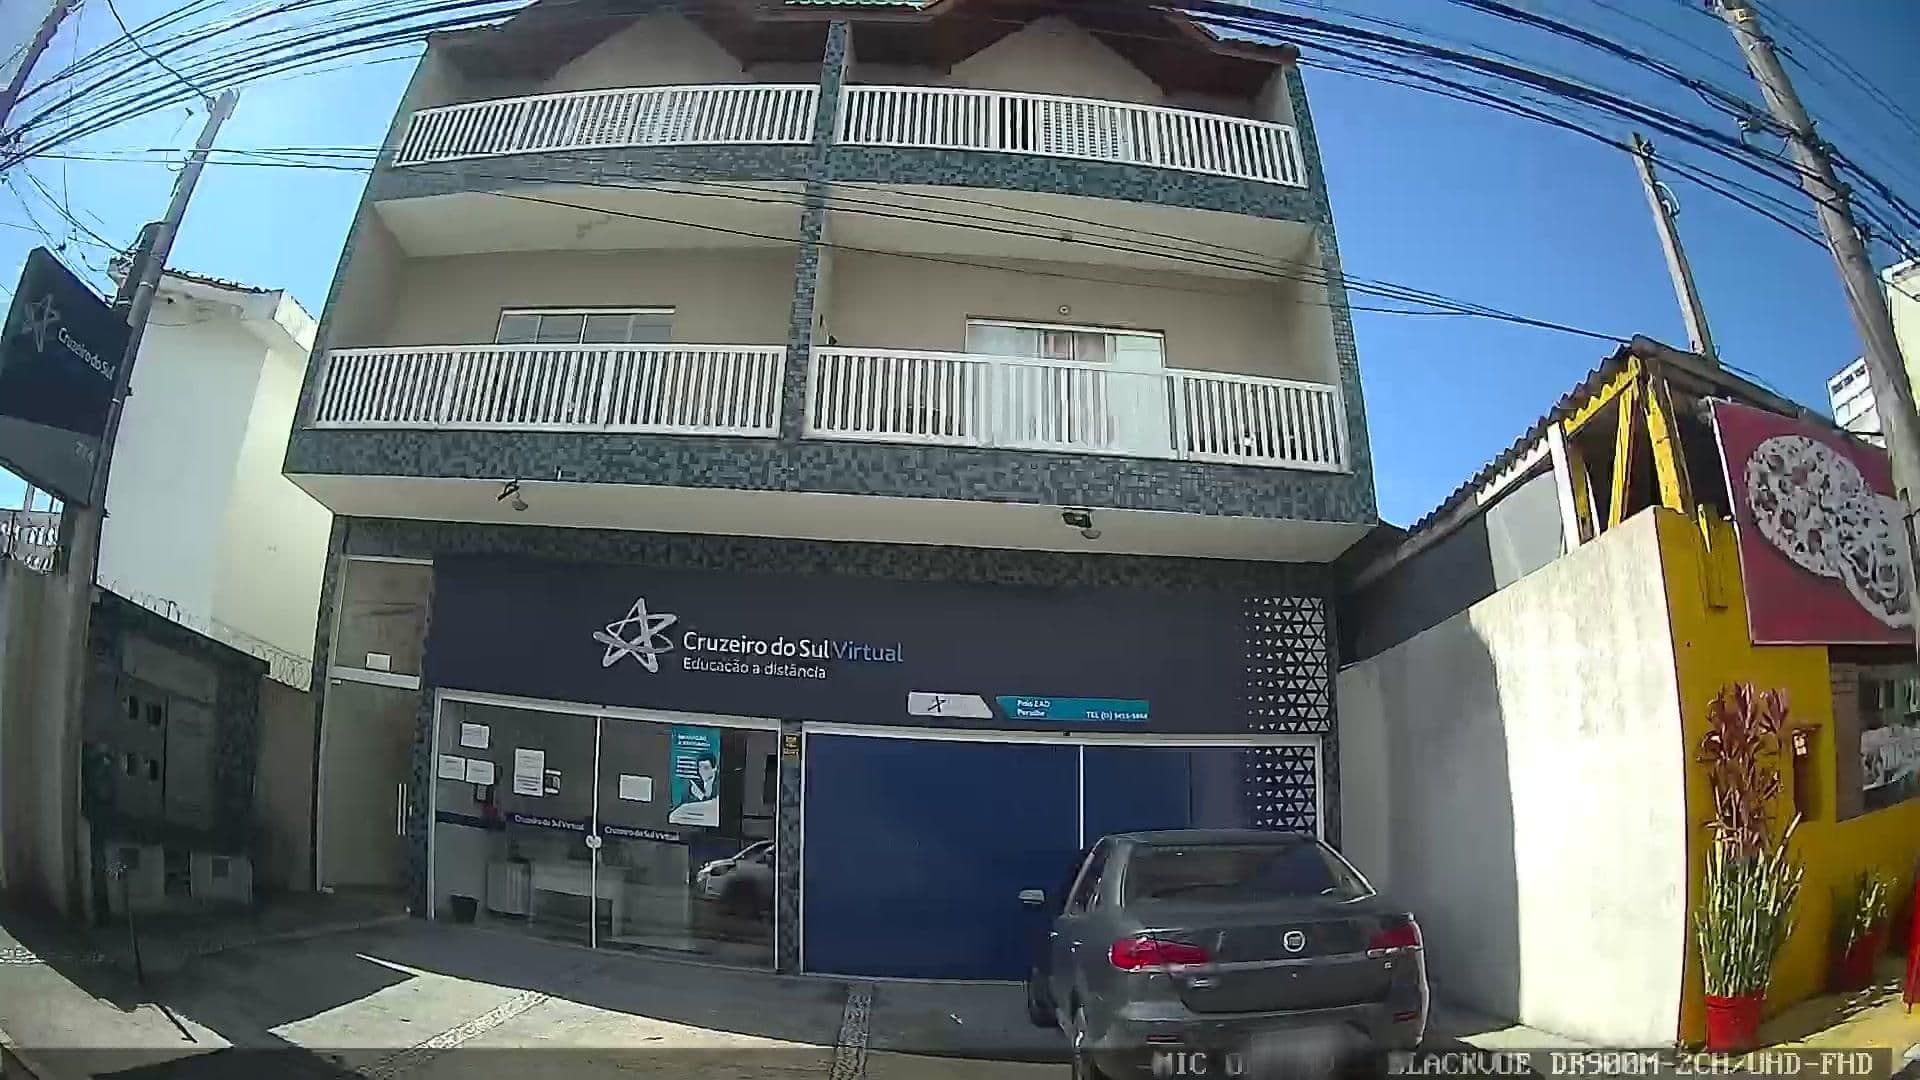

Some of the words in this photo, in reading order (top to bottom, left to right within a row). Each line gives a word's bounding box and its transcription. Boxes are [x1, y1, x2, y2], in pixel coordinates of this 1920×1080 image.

[58, 327, 91, 361] Cruzeiro
[90, 353, 102, 371] do
[100, 361, 116, 381] Sul
[683, 631, 767, 656] Cruzeiro
[771, 636, 796, 657] do
[799, 639, 829, 660] Sul
[832, 641, 904, 663] Virtual
[752, 663, 761, 676] a
[764, 661, 827, 680] distância
